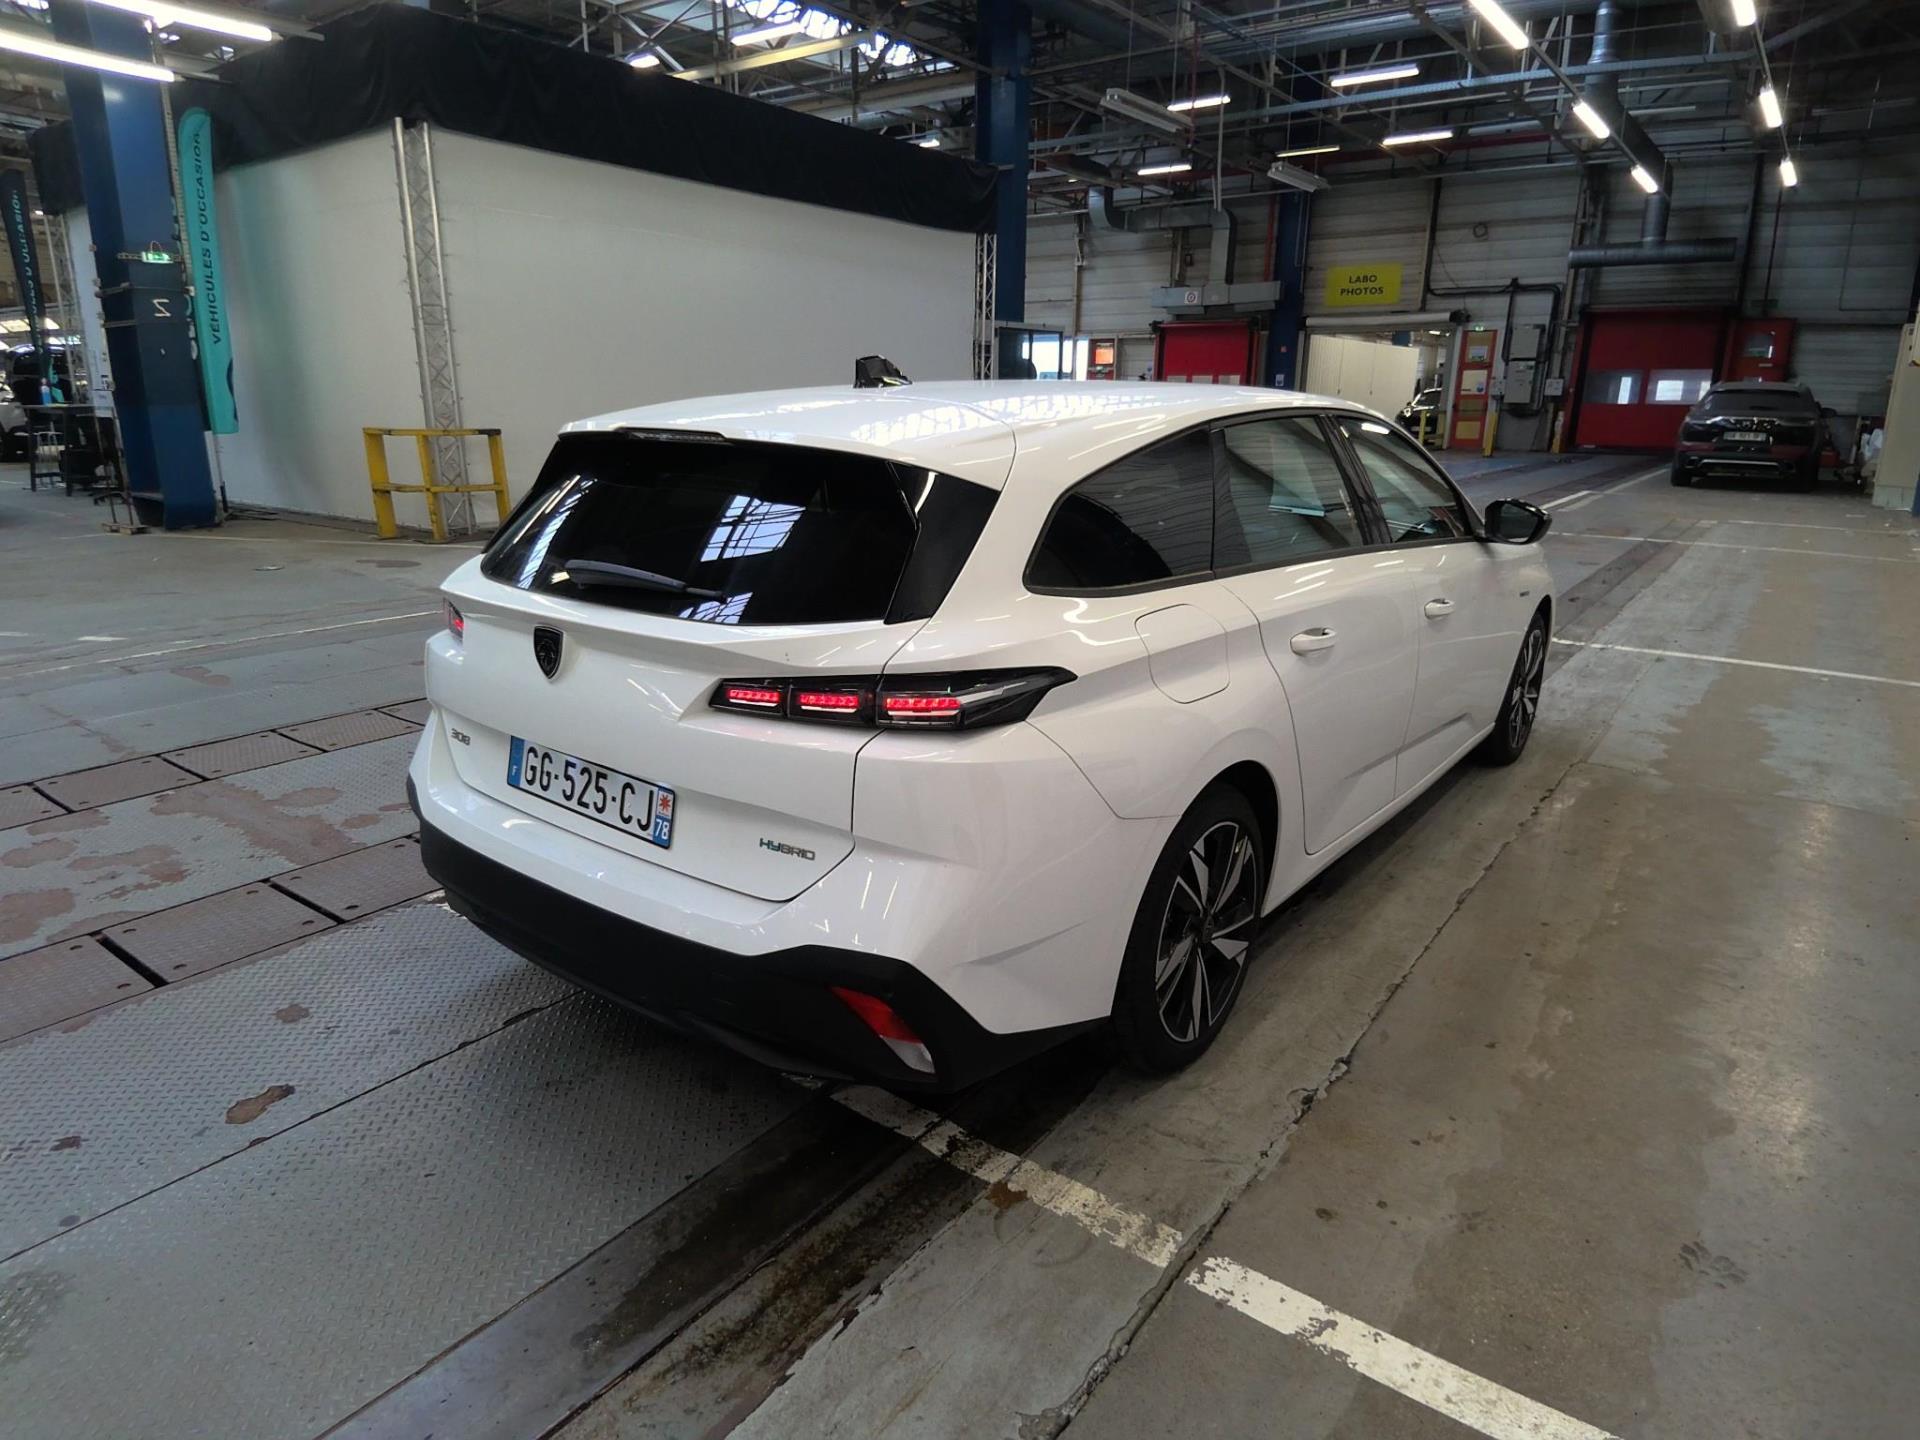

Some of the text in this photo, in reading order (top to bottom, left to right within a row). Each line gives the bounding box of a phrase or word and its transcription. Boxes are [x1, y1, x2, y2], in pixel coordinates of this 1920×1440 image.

[1349, 275, 1377, 284] LABO
[1340, 287, 1384, 296] PHOTOS
[451, 727, 471, 745] 308
[655, 819, 670, 840] 78
[759, 838, 815, 860] HYBRID
